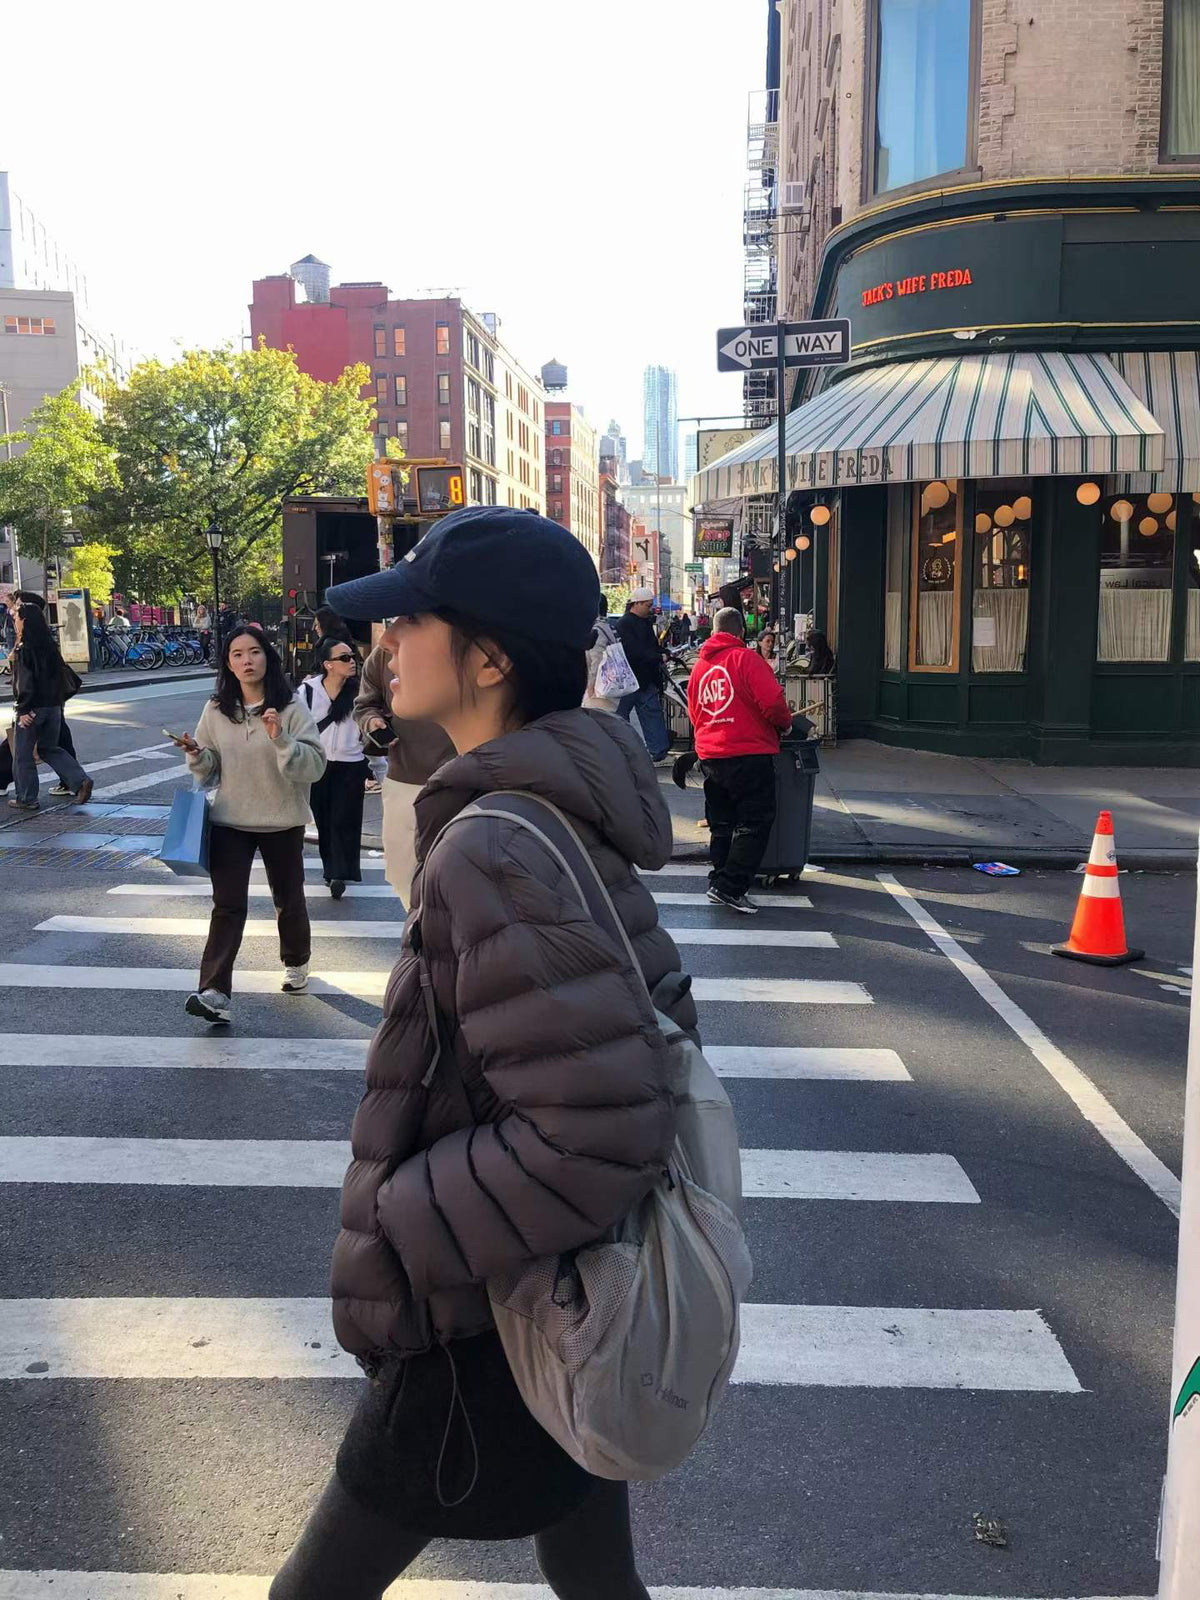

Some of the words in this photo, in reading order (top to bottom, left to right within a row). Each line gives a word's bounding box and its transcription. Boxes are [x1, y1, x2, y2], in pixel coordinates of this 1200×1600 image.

[861, 282, 894, 307] JACK'S
[896, 275, 927, 296] WIFE
[930, 268, 973, 290] FREDA
[734, 339, 773, 358] ONE
[795, 333, 838, 353] WAY
[737, 463, 779, 490] JACK'S
[787, 459, 827, 483] WIFE
[835, 454, 894, 479] FREDA
[450, 476, 463, 503] 8
[701, 541, 728, 552] SHOP
[704, 529, 731, 541] STOP
[703, 678, 726, 705] ACE
